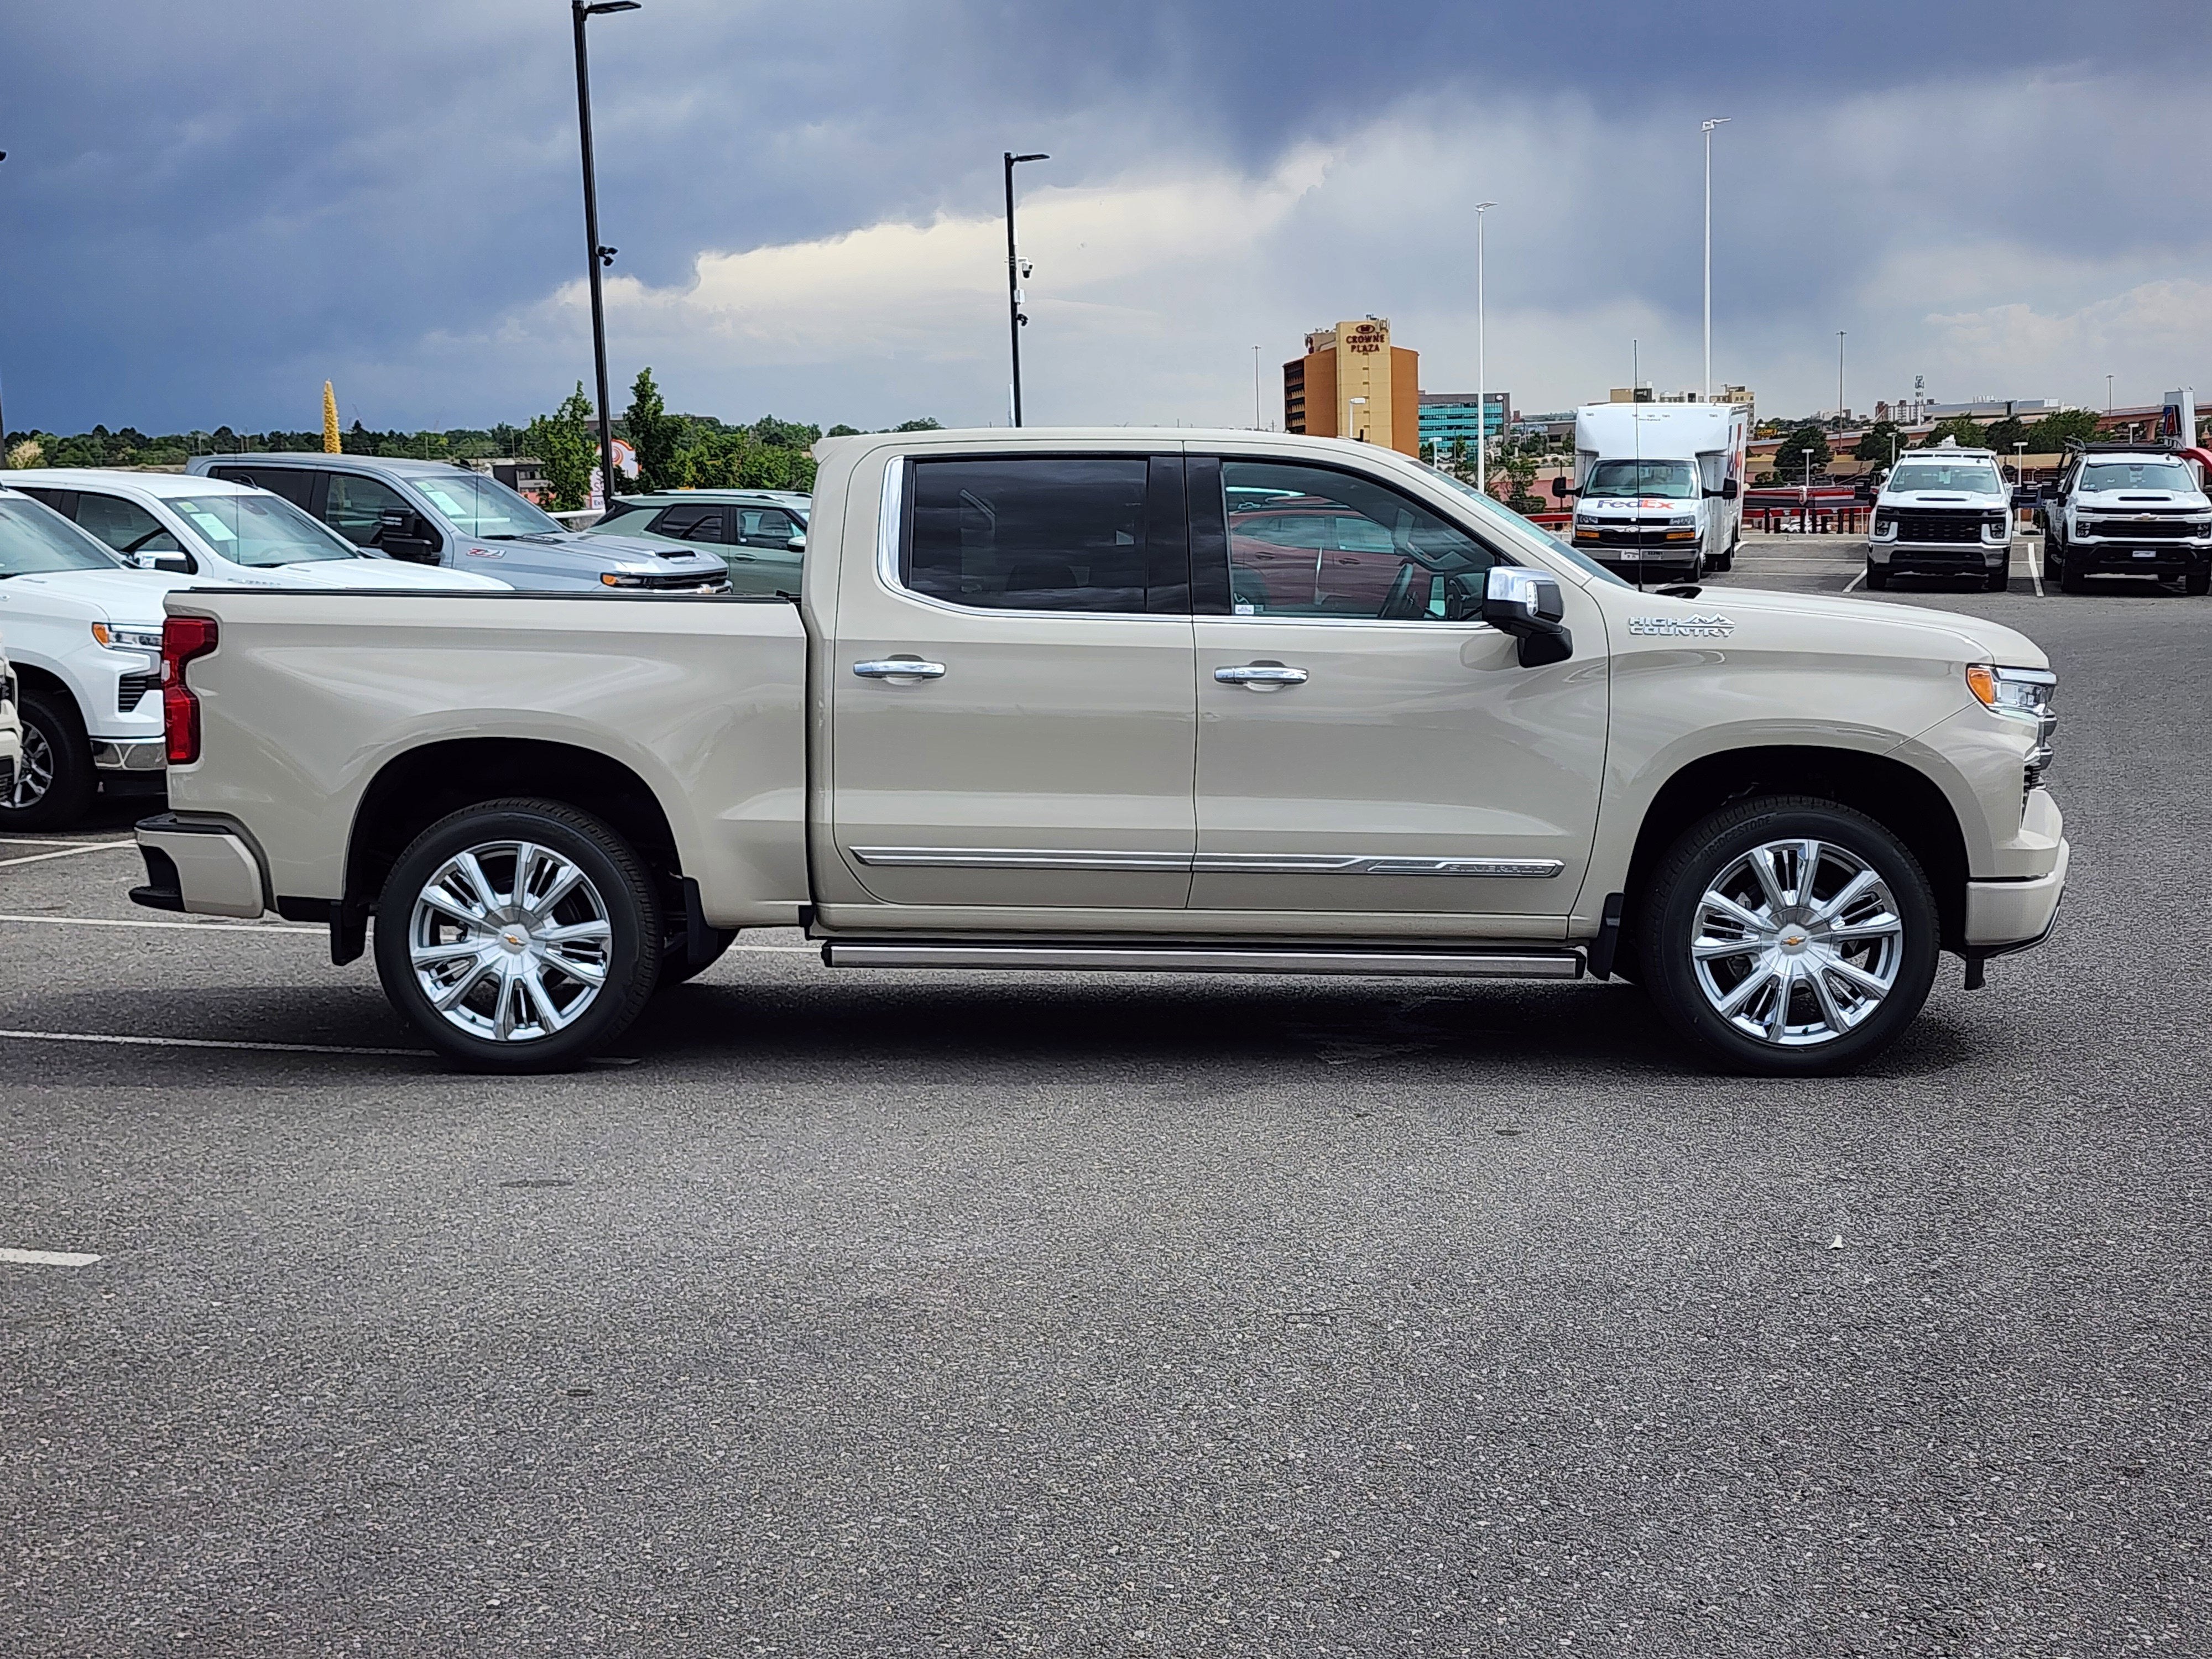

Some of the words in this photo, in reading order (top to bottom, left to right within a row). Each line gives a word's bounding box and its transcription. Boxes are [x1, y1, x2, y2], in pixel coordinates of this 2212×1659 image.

[1346, 334, 1385, 344] CROWNE
[1350, 344, 1380, 353] PLAZA
[1597, 499, 1675, 509] FedEx
[1629, 617, 1682, 627] HIGH
[1629, 627, 1735, 637] COUNTRY
